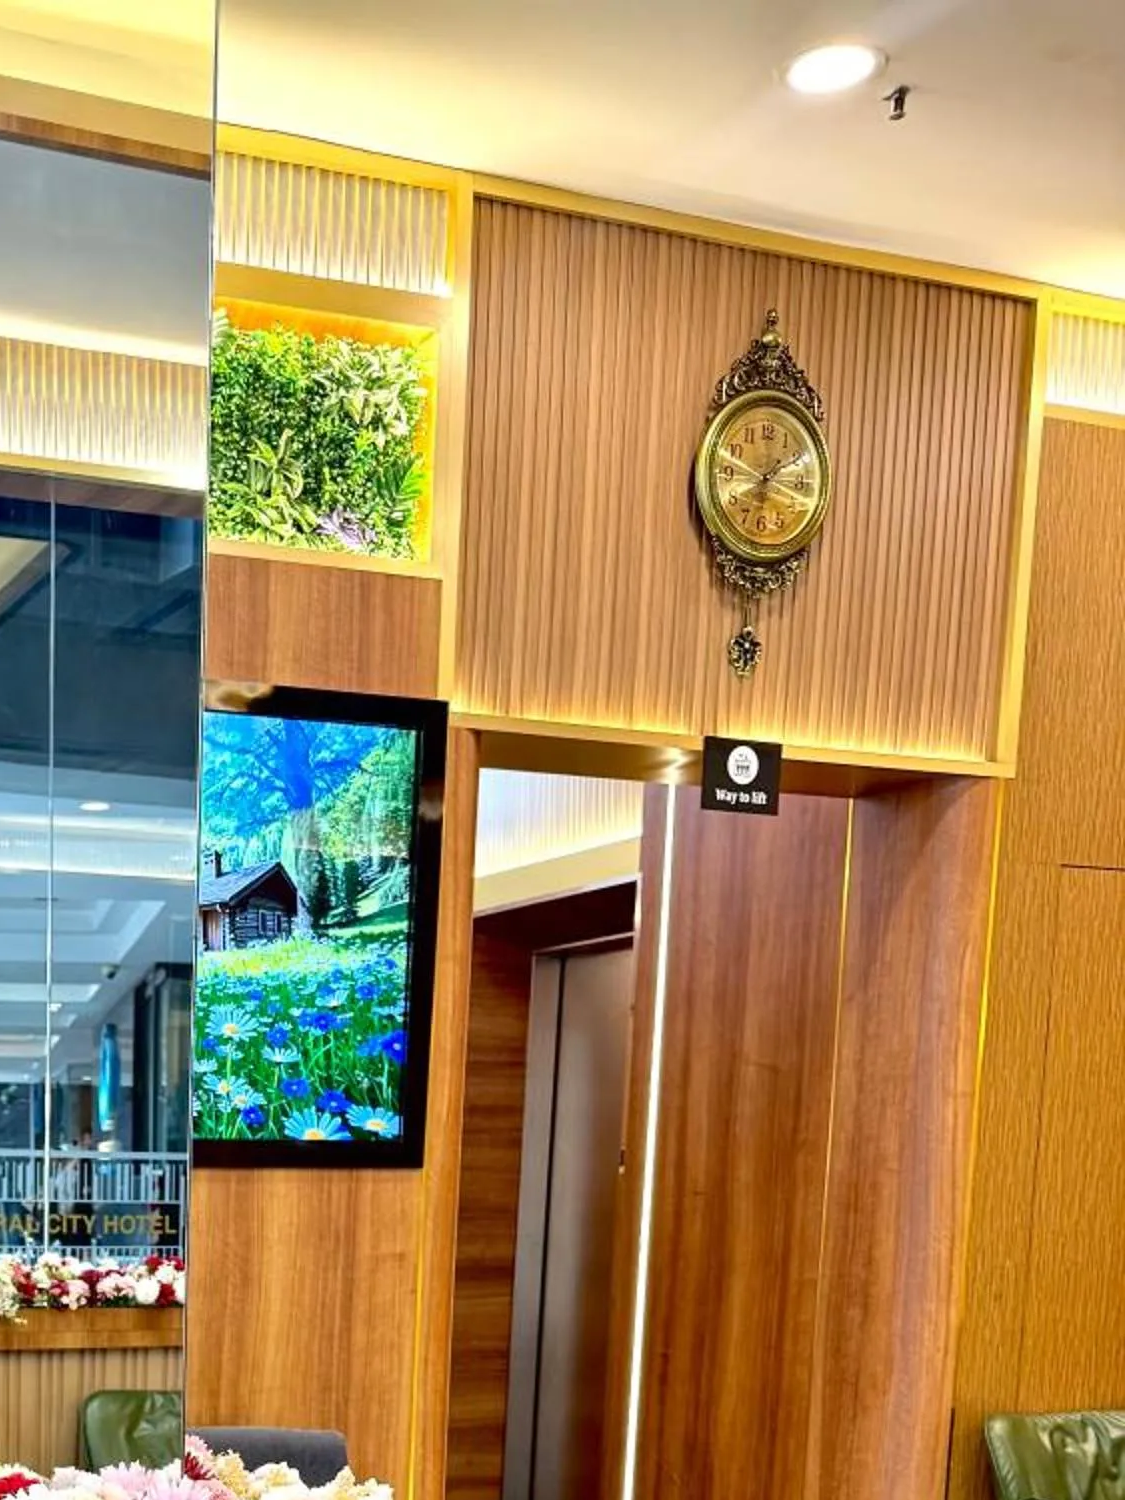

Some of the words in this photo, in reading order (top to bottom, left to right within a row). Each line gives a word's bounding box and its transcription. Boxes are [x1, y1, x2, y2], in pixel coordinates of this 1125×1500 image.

[744, 427, 754, 444] 11
[762, 423, 774, 441] 12
[731, 443, 743, 459] 10
[724, 466, 734, 482] 9
[741, 508, 750, 525] 7
[756, 515, 767, 532] 6
[775, 512, 784, 529] 5
[715, 788, 738, 805] Way
[739, 791, 750, 803] to
[751, 791, 767, 805] lift
[46, 1211, 97, 1236] CITY
[102, 1213, 179, 1236] HOTEL
